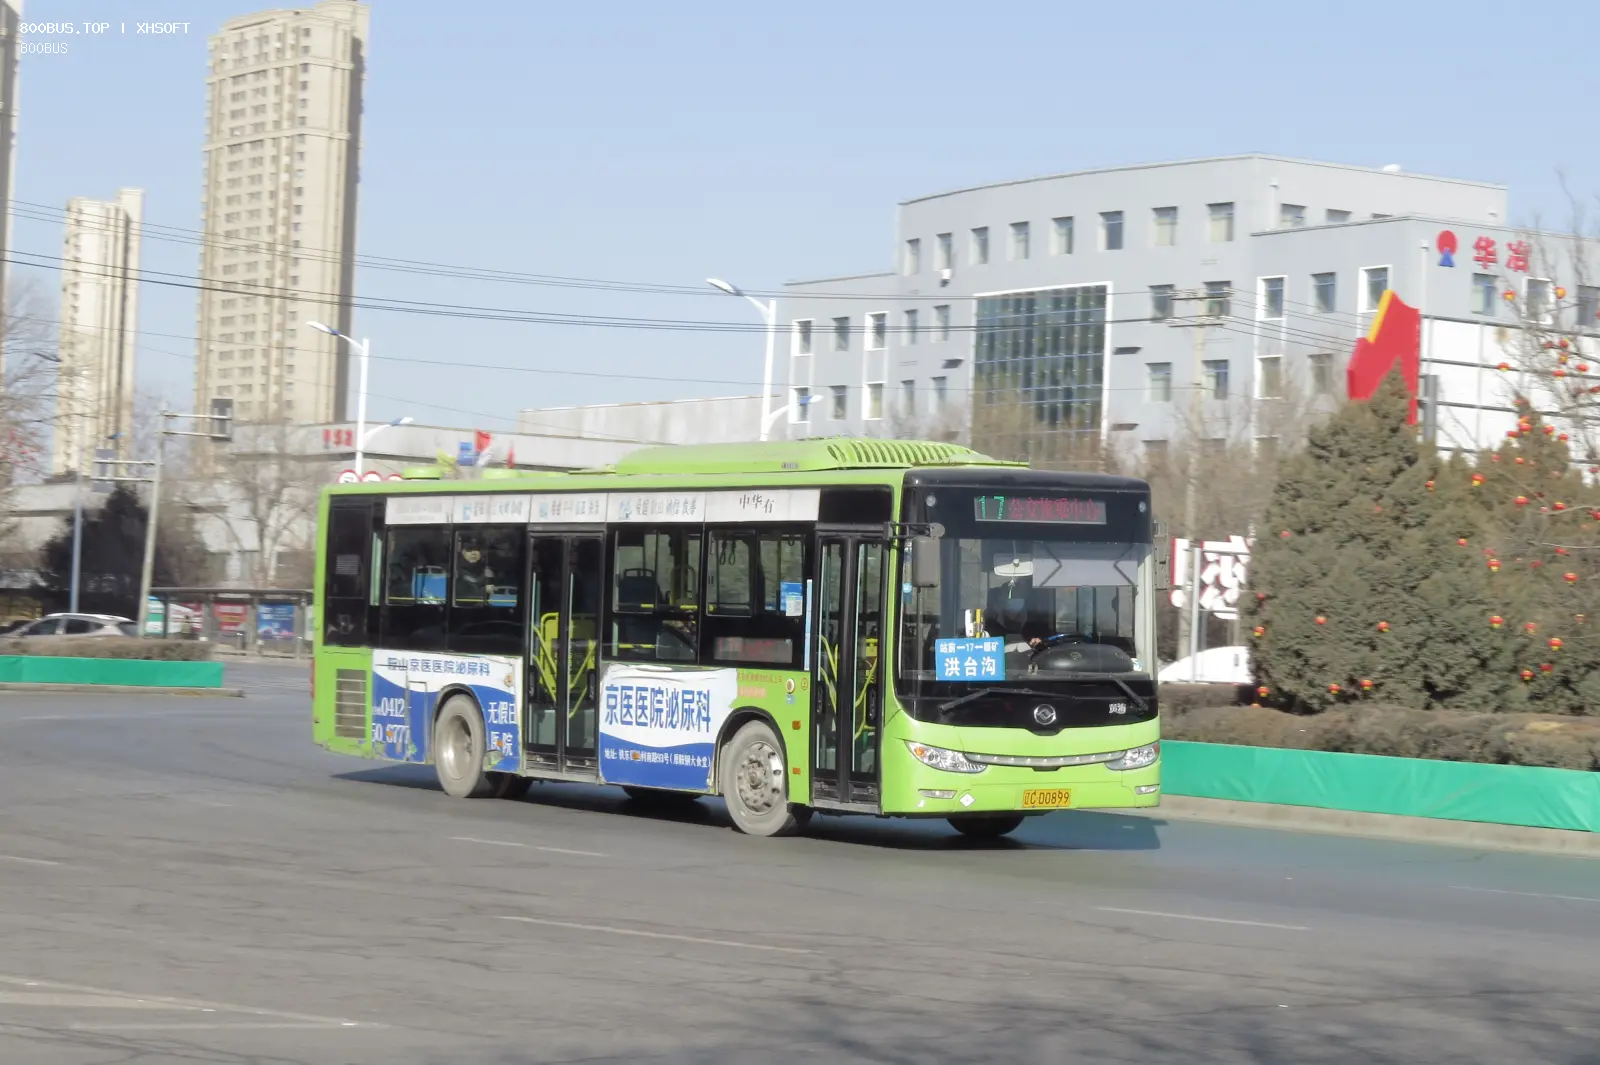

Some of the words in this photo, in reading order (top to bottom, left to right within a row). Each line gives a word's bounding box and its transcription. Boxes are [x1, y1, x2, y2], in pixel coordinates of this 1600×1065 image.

[978, 496, 1005, 519] 17
[944, 656, 996, 677] 洪台沟
[488, 701, 516, 725] 无假日
[605, 684, 711, 732] 京医医院泌尿科
